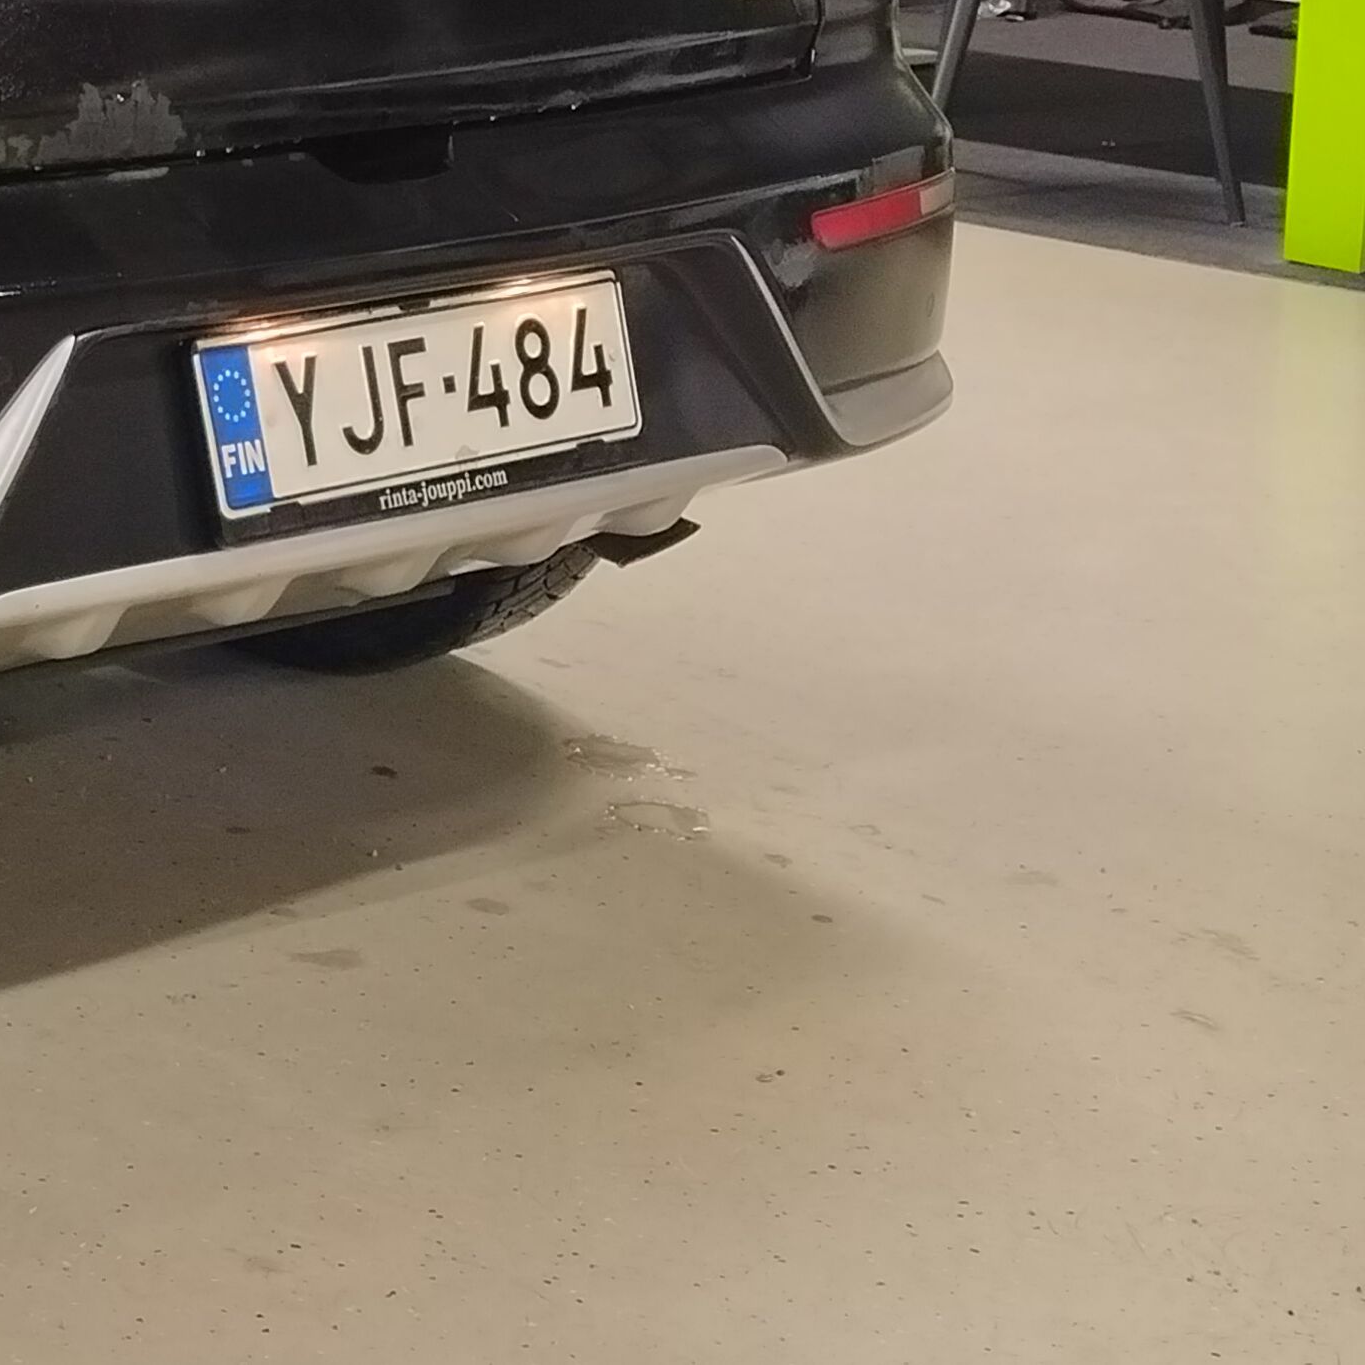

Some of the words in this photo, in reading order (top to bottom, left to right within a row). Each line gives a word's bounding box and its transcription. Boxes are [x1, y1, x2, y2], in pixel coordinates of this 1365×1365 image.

[273, 305, 614, 467] YJF-484
[221, 439, 266, 478] FIN
[378, 469, 508, 510] rinta-jouppi.com
